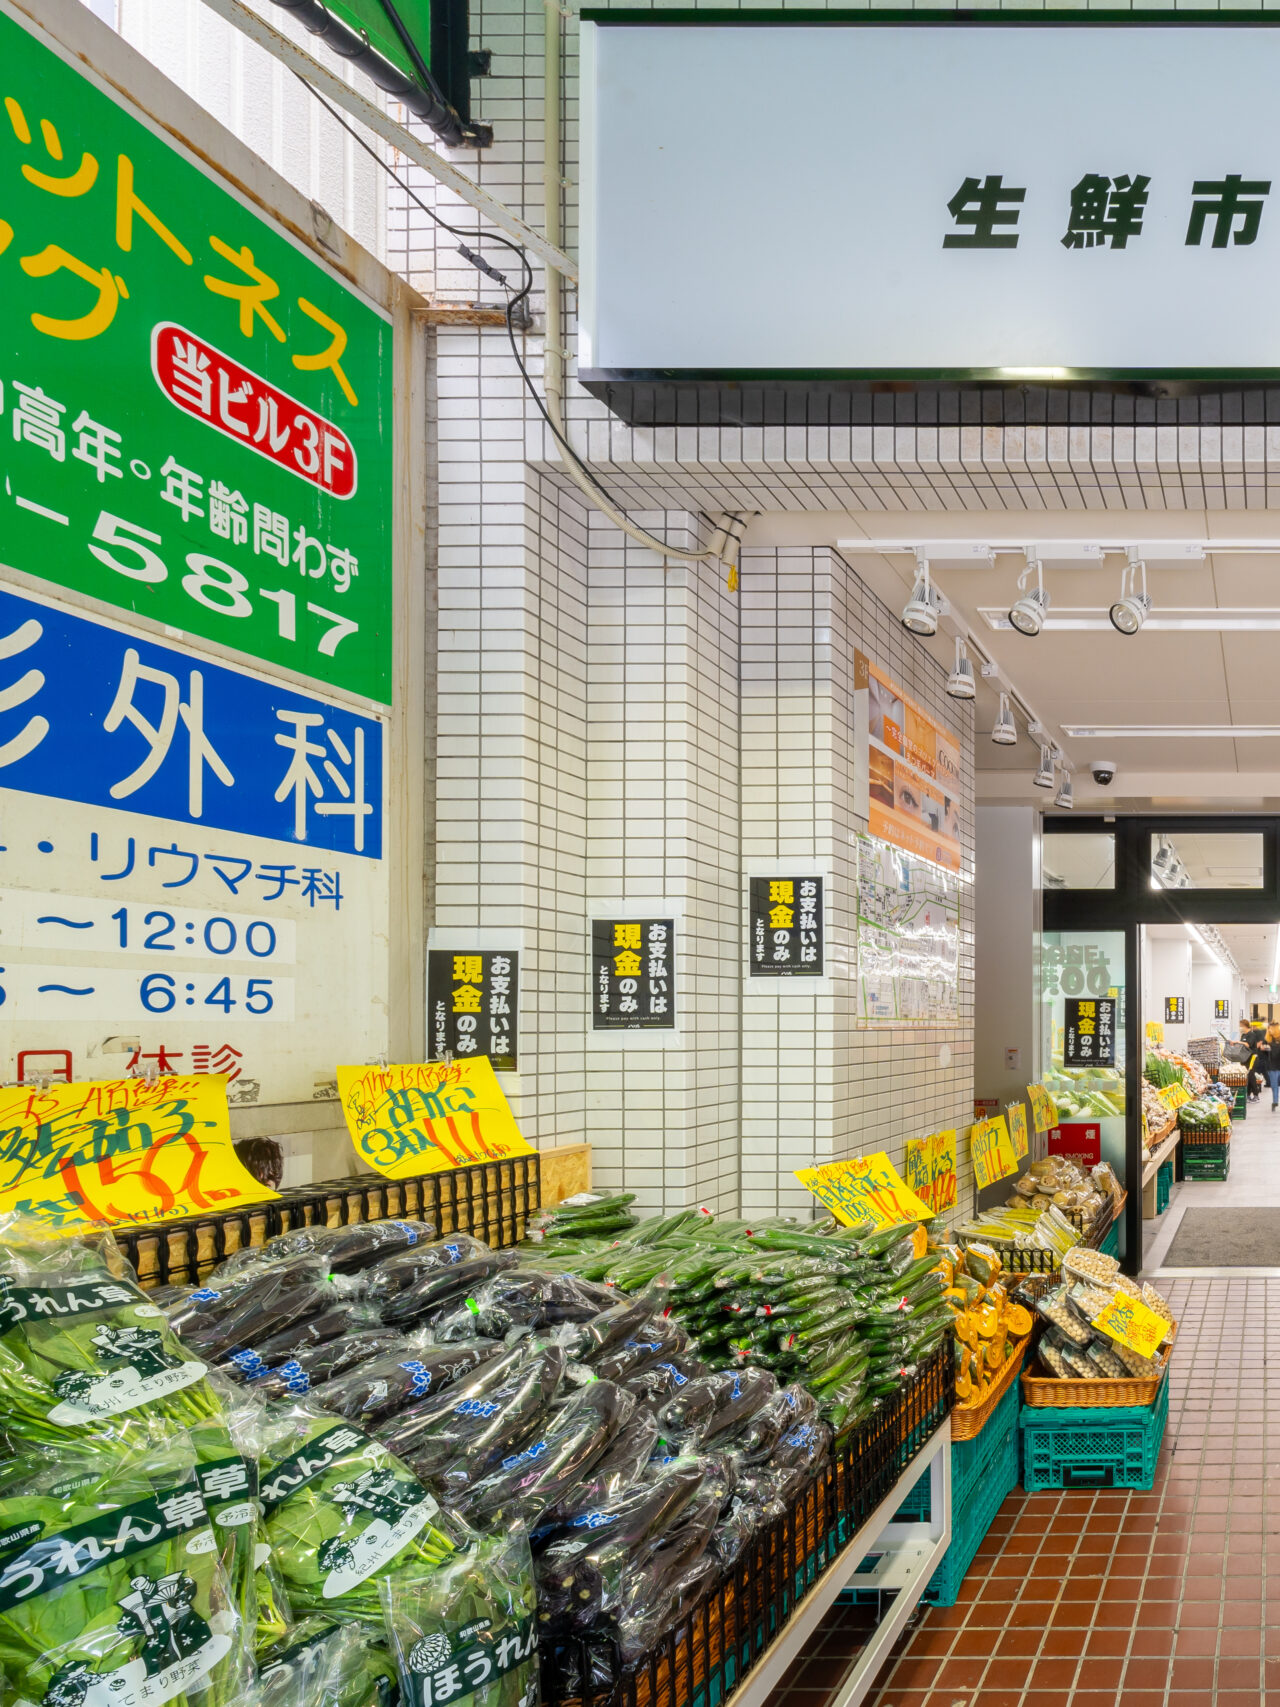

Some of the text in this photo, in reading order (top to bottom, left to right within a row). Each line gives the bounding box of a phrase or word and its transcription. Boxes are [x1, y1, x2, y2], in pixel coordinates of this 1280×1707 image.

[171, 334, 347, 485] 当ビル3F
[0, 379, 360, 594] 高年。年齢問わず
[0, 832, 344, 911] ・リウマチ科
[755, 919, 764, 961] となります
[769, 880, 794, 961] 現金のみ
[800, 880, 816, 962] お支払いは
[140, 973, 274, 1014] 6:45
[452, 956, 483, 1053] 現金のみ
[490, 956, 511, 1054] お支払いは
[599, 966, 610, 1013] となります
[613, 924, 642, 1013] 現金のみ
[648, 924, 668, 1014] お支払いは
[1078, 1001, 1096, 1057] 現金のみ
[1099, 1001, 1111, 1058] お支払いは
